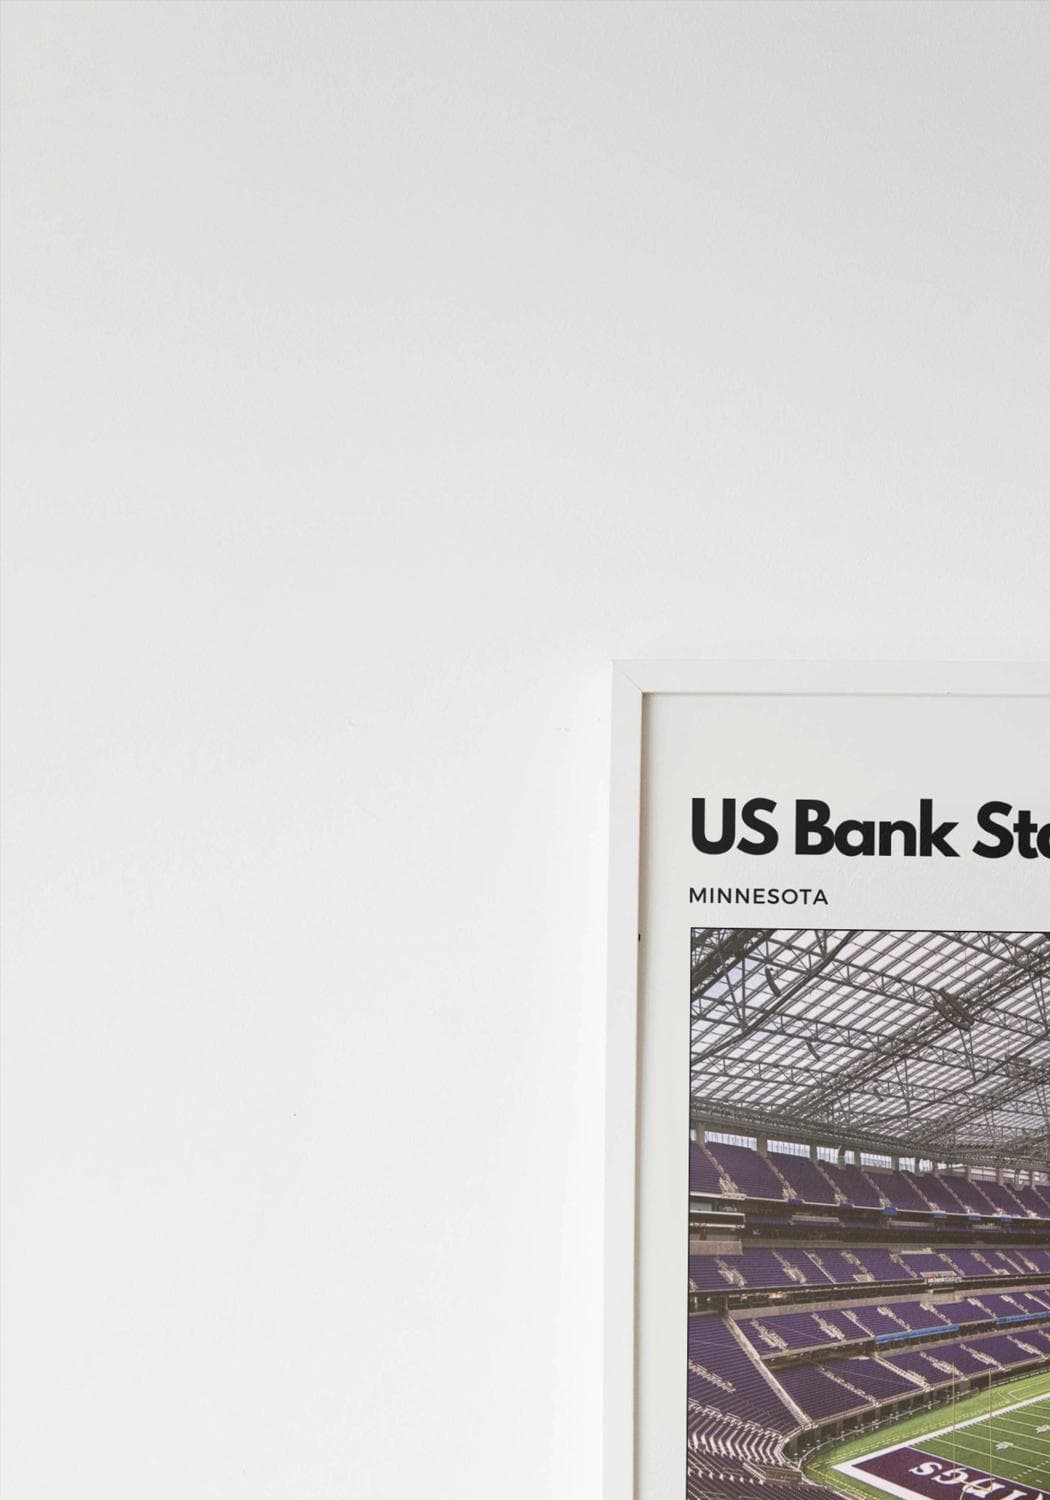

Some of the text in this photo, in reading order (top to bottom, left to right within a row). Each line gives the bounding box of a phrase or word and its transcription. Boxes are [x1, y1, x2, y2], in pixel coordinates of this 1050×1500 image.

[691, 797, 779, 856] US
[794, 798, 961, 858] Bank
[688, 887, 829, 906] MINNESOTA
